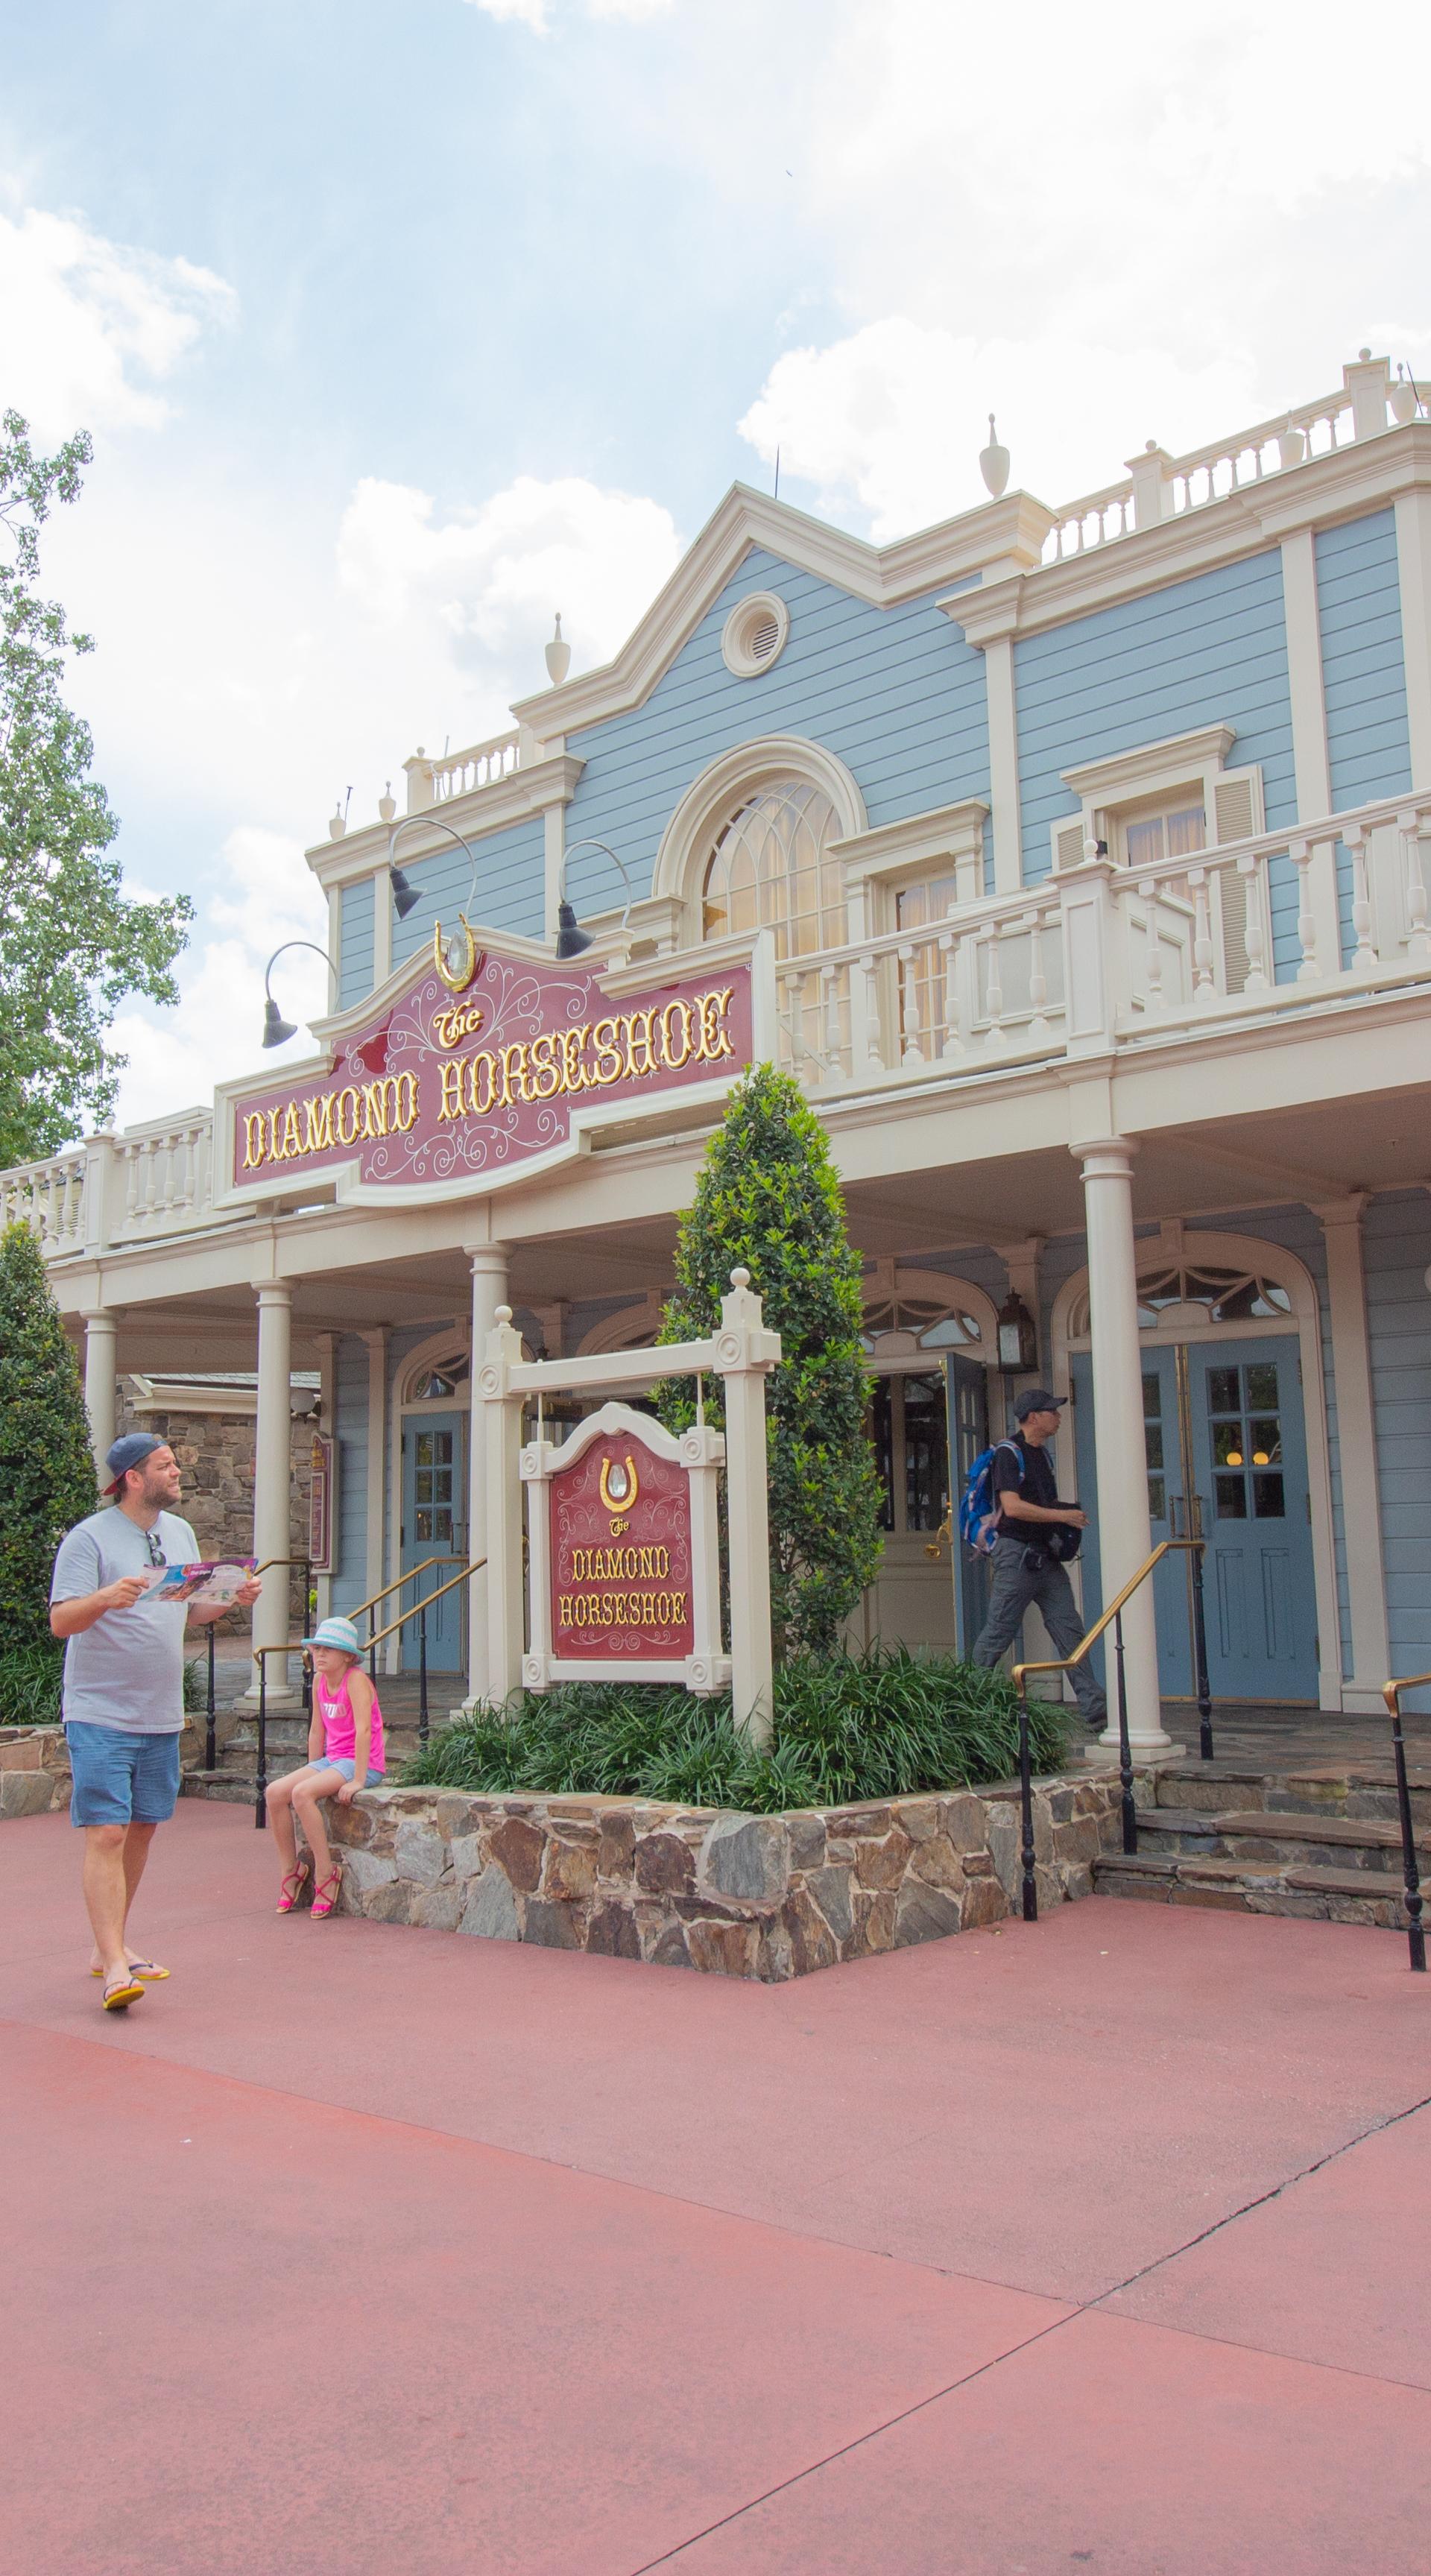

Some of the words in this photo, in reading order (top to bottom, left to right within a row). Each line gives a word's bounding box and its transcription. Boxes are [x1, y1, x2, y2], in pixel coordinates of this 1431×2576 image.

[433, 1001, 483, 1048] The
[242, 1070, 420, 1168] DIAMOND
[437, 986, 735, 1122] HORSESHOE
[609, 1517, 630, 1537] The
[572, 1546, 670, 1581] DIAMOND
[559, 1592, 687, 1626] HORSESHOE
